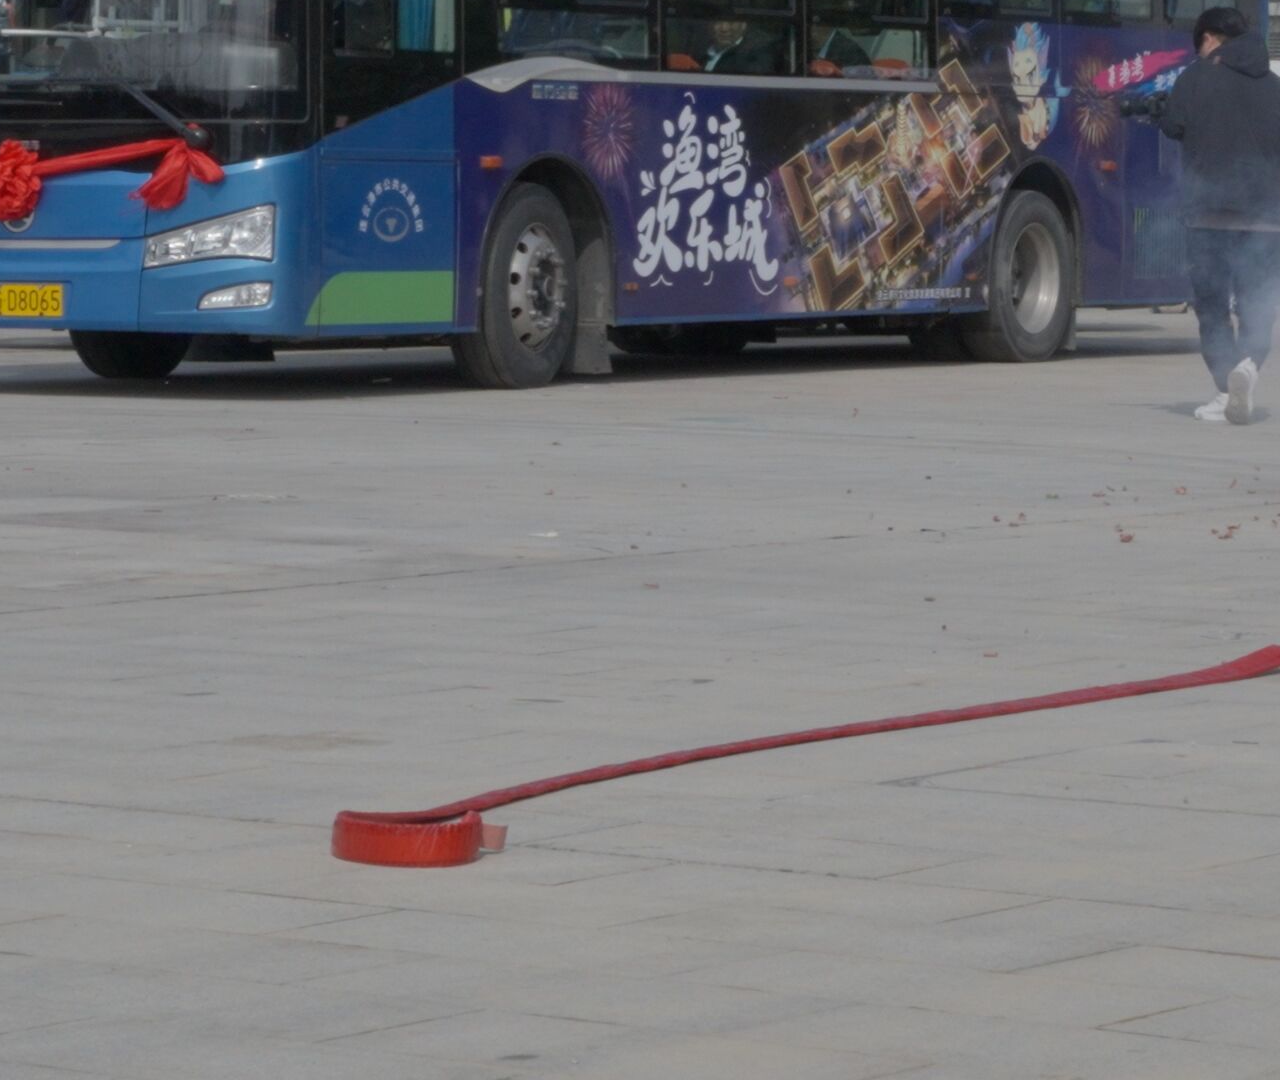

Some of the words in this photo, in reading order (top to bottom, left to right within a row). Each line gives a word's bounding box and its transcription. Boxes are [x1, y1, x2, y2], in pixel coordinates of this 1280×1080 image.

[659, 104, 747, 197] 渔湾
[633, 183, 779, 281] 欢乐城
